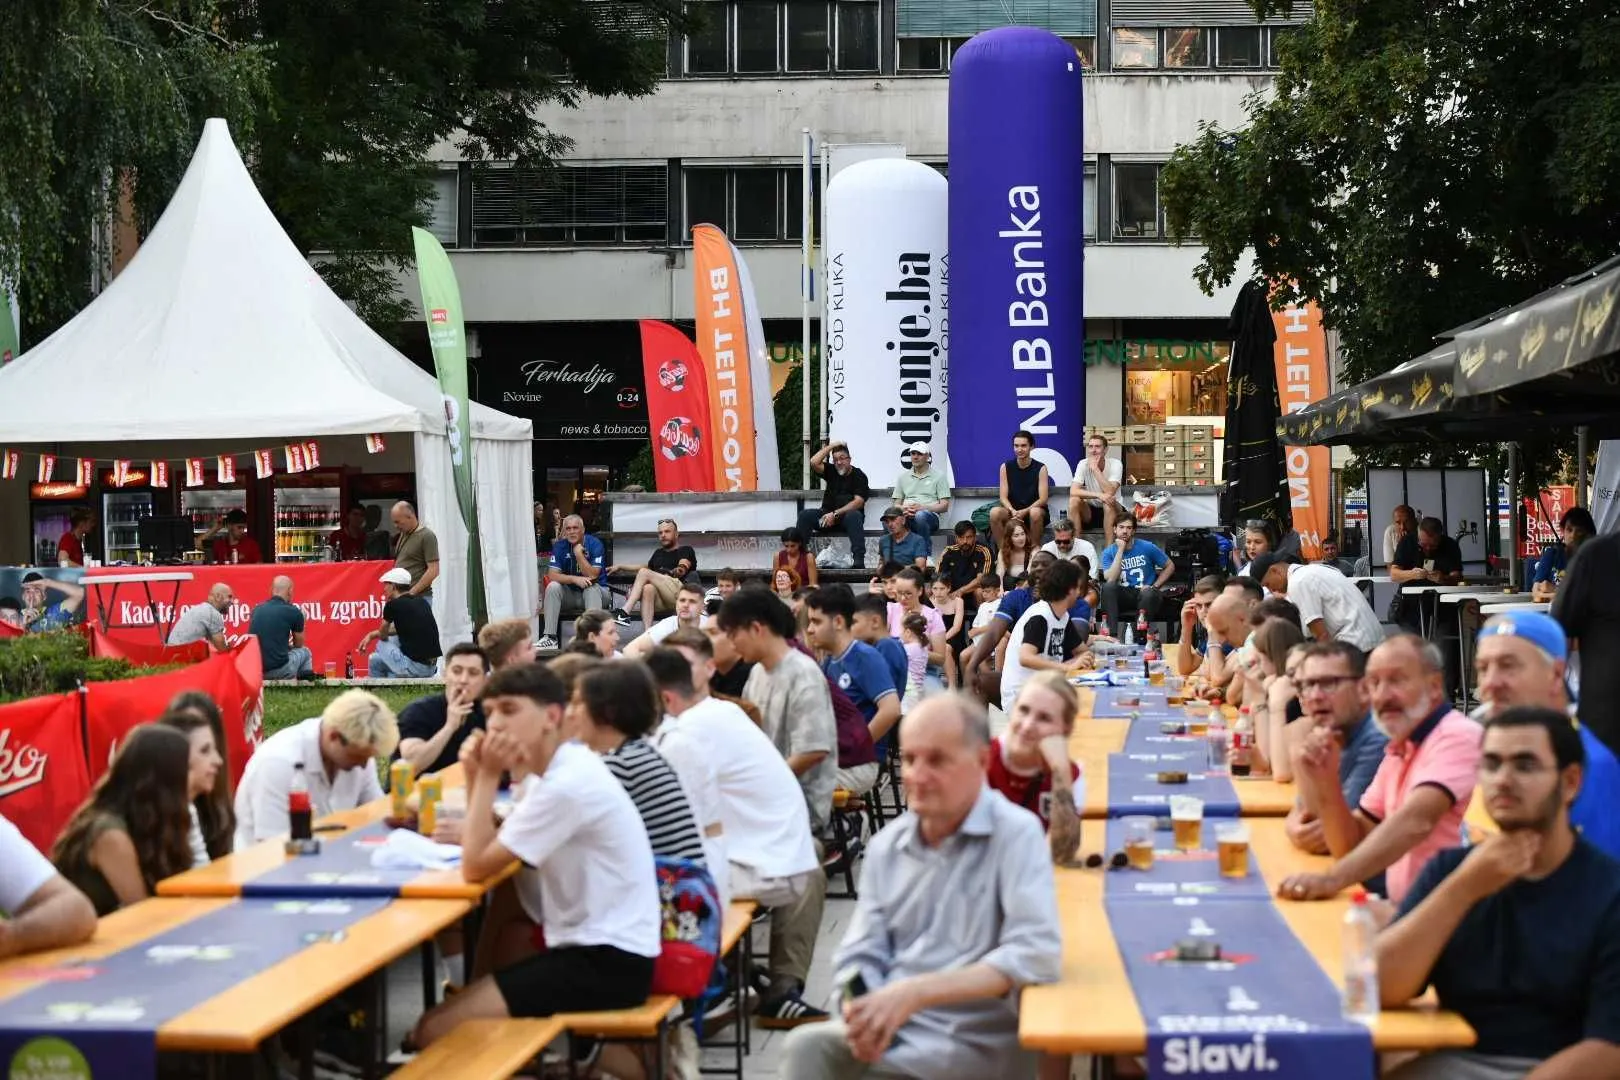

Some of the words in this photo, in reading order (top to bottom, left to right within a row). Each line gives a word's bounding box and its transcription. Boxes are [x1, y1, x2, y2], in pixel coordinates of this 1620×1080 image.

[998, 185, 1049, 327] Banka
[832, 252, 844, 311] KLIKA
[832, 317, 844, 352] OD
[1084, 339, 1218, 366] ENETTON
[520, 359, 616, 394] Ferhadija
[1012, 337, 1058, 434] NLB
[616, 394, 639, 402] 0-24
[560, 425, 590, 434] news
[593, 423, 601, 434] &
[604, 424, 647, 434] tobacco
[331, 595, 386, 625] zgrabi
[1164, 1033, 1279, 1074] Slavi.
